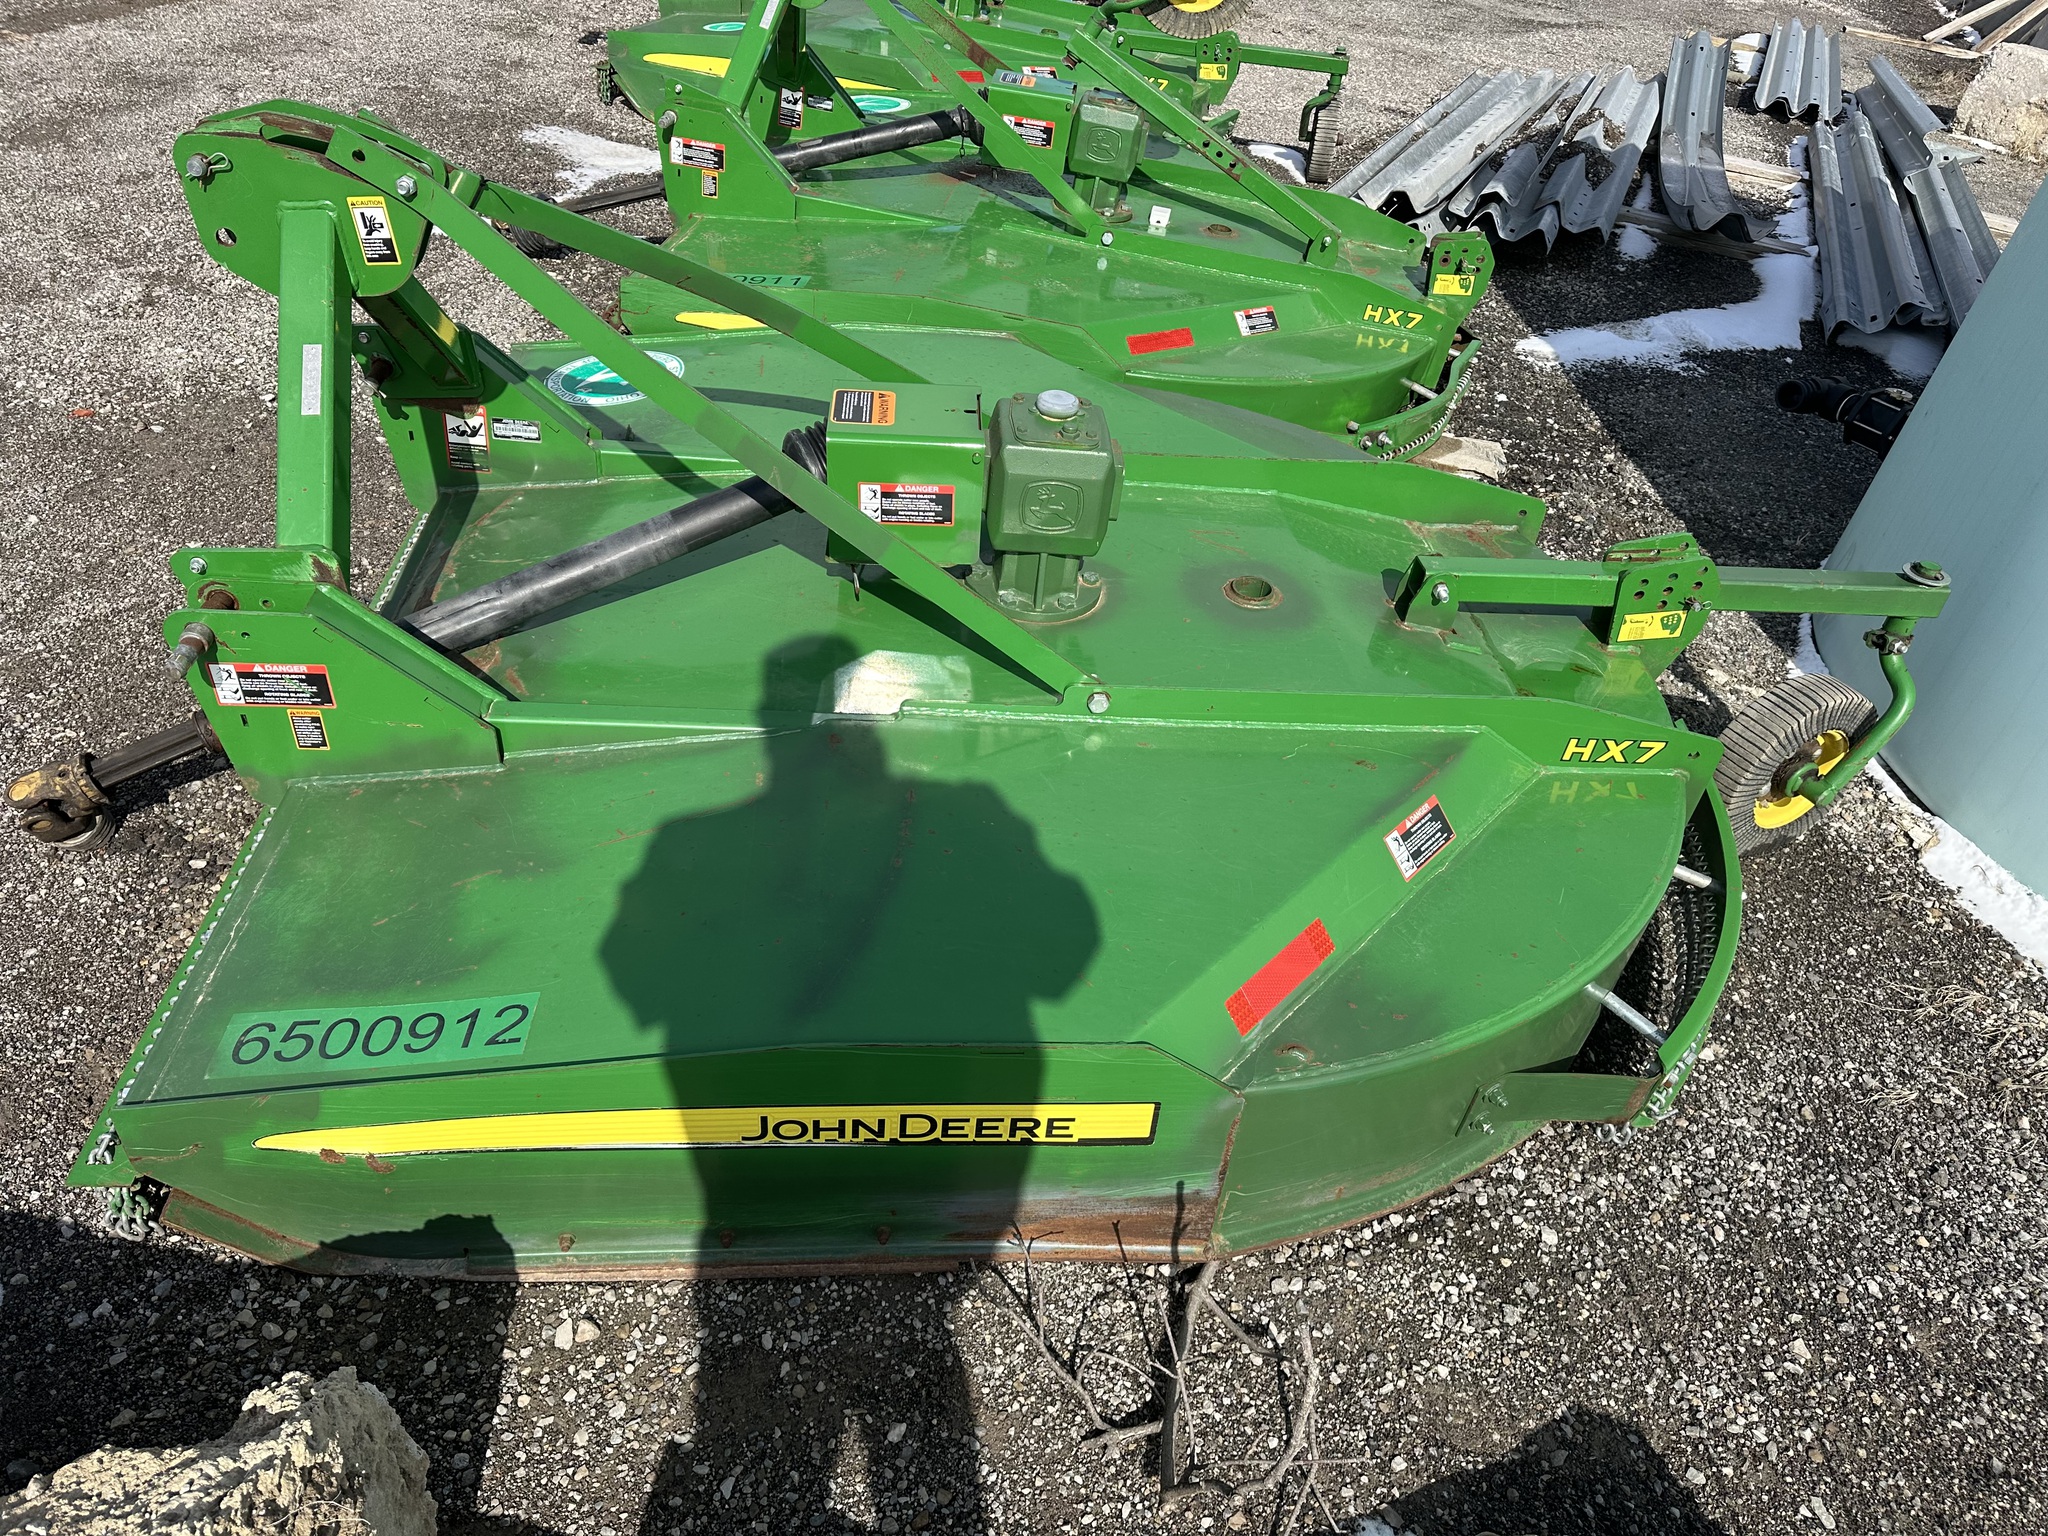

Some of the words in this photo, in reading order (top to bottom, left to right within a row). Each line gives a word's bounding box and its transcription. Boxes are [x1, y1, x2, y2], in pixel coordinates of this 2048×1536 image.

[1362, 303, 1425, 330] HX7
[605, 391, 640, 403] OHIO
[878, 398, 889, 424] WARNING
[904, 485, 939, 493] DANGER
[264, 664, 308, 673] DANGER
[1560, 737, 1669, 764] HX7
[1409, 803, 1431, 824] DANGER
[231, 1004, 529, 1065] 6500912
[741, 1115, 886, 1142] JOHN
[899, 1113, 1077, 1139] DEERE
